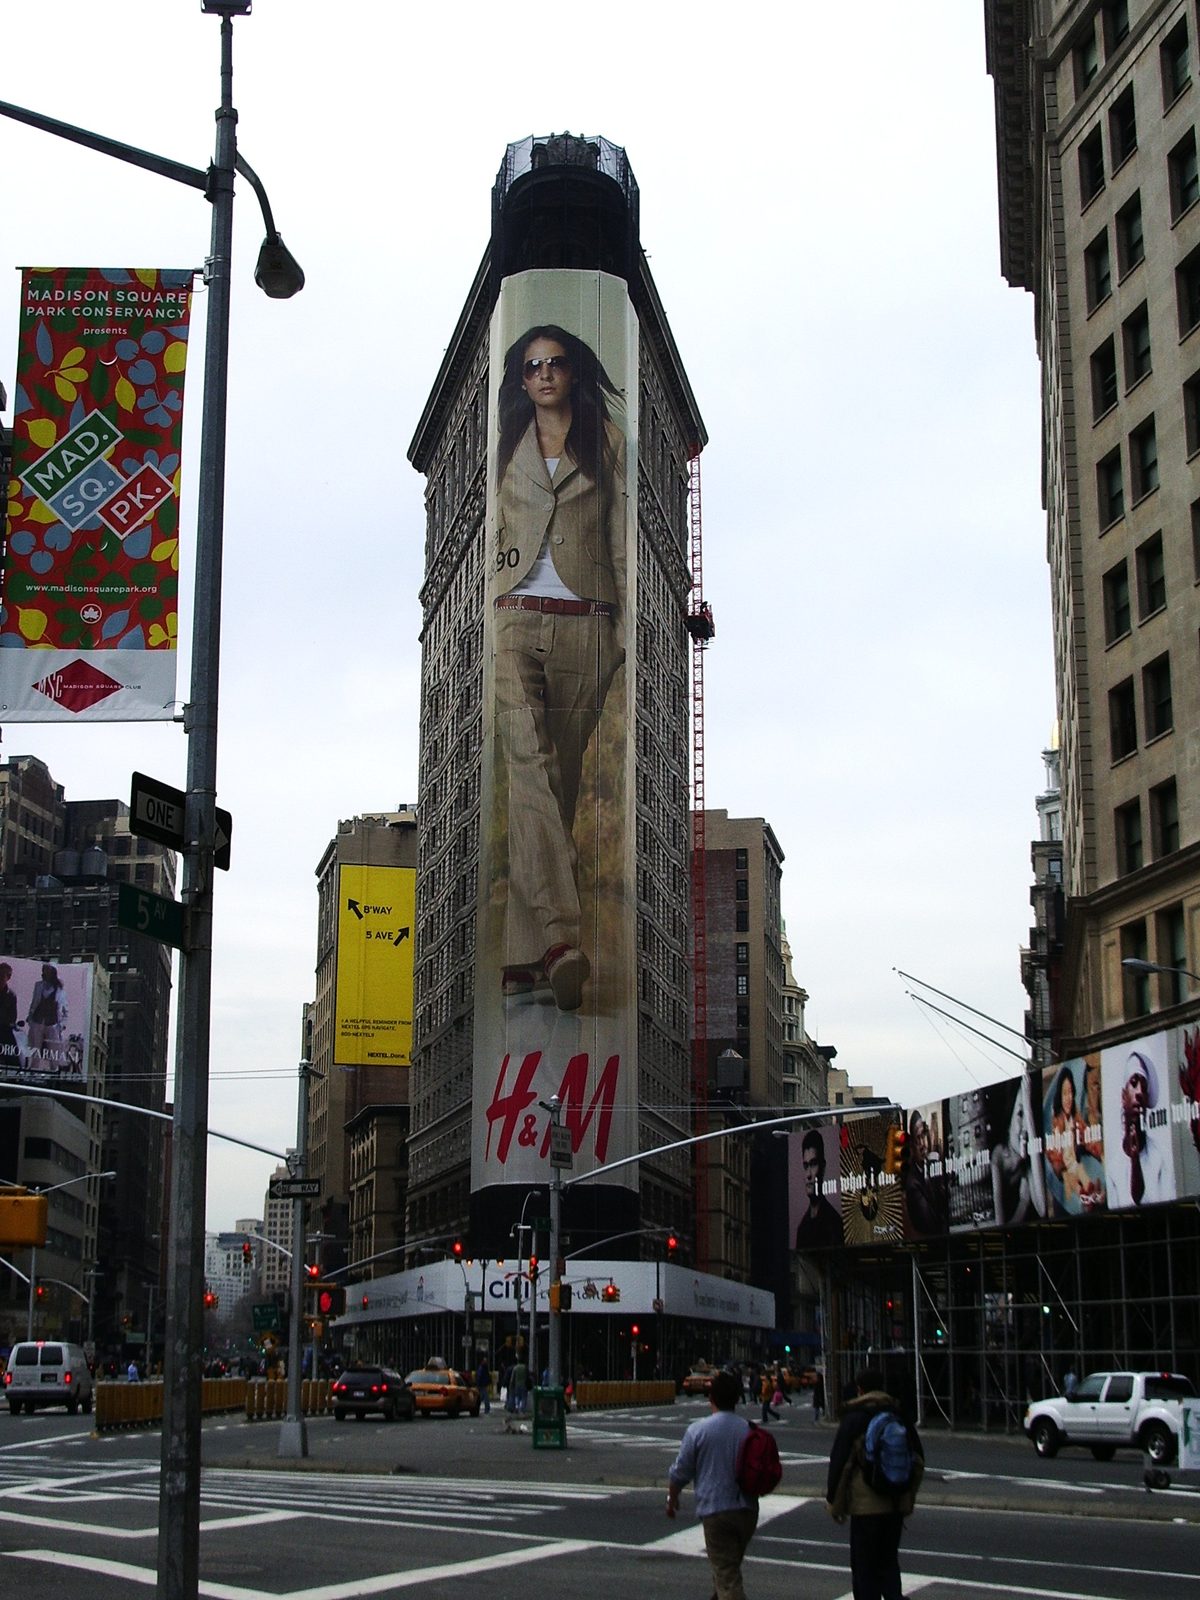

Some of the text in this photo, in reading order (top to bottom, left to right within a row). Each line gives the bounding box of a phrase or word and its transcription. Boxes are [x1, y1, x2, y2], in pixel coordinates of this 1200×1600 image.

[28, 290, 187, 304] MADISON SQUARE
[26, 306, 186, 318] PARK CONSERVANCY
[84, 327, 128, 336] presents
[34, 431, 109, 491] MAD.
[62, 478, 115, 517] SQ.
[110, 482, 162, 525] PK.
[26, 584, 158, 594] www.madisonsquarepark.org
[146, 798, 174, 828] ONE
[136, 894, 150, 931] 5
[364, 906, 392, 914] B'WAY
[366, 931, 393, 940] 5 AVE
[32, 1048, 79, 1064] ARMANI
[485, 1050, 620, 1164] H&M
[276, 1184, 317, 1193] ONE WAY
